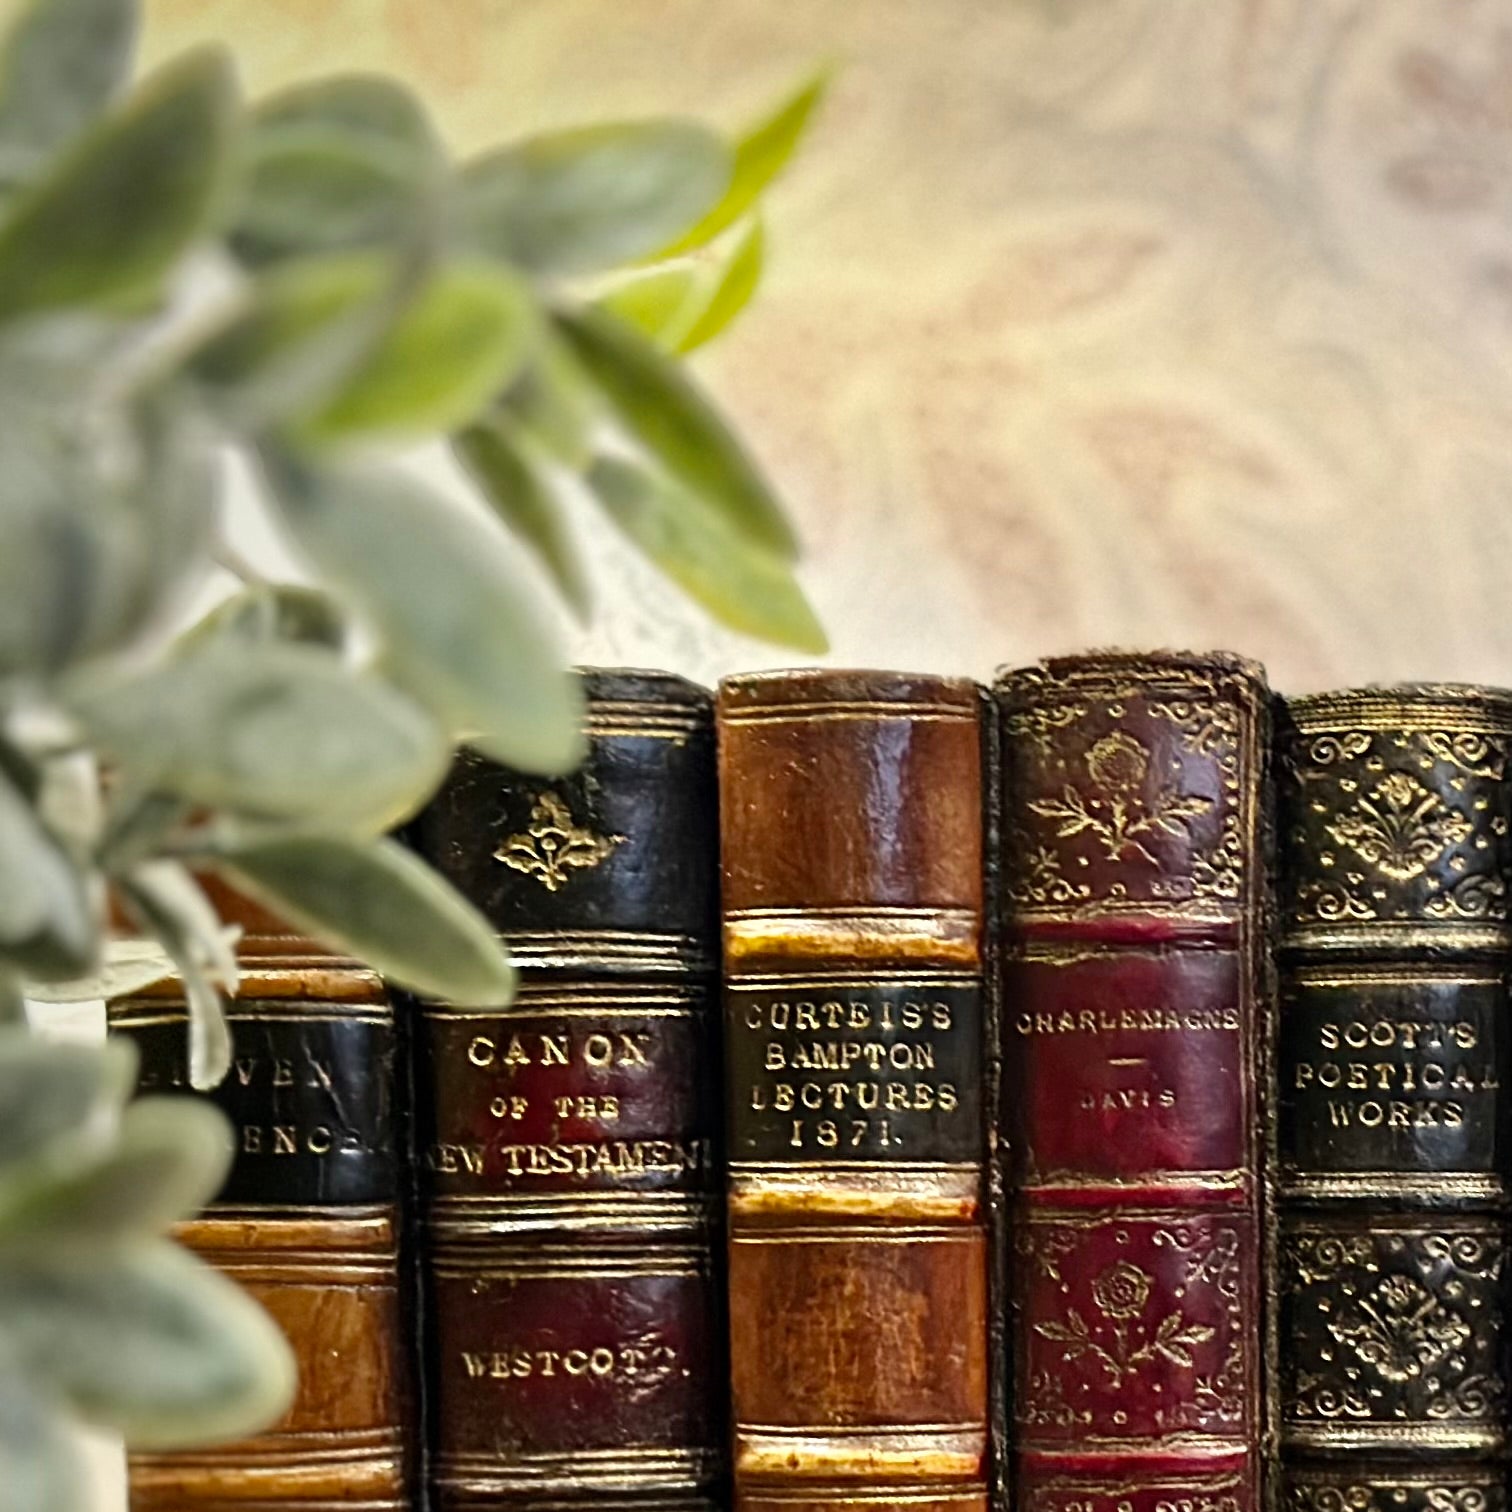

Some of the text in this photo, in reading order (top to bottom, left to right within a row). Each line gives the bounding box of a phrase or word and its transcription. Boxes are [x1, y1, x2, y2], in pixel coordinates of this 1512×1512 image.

[1015, 1008, 1241, 1035] CHARLEMAGNE
[467, 1034, 652, 1067] CANON
[765, 1042, 936, 1070] BAMPTON
[1295, 1062, 1500, 1092] POETICAL
[490, 1096, 619, 1120] OF THE
[751, 1082, 959, 1112] LECTURES
